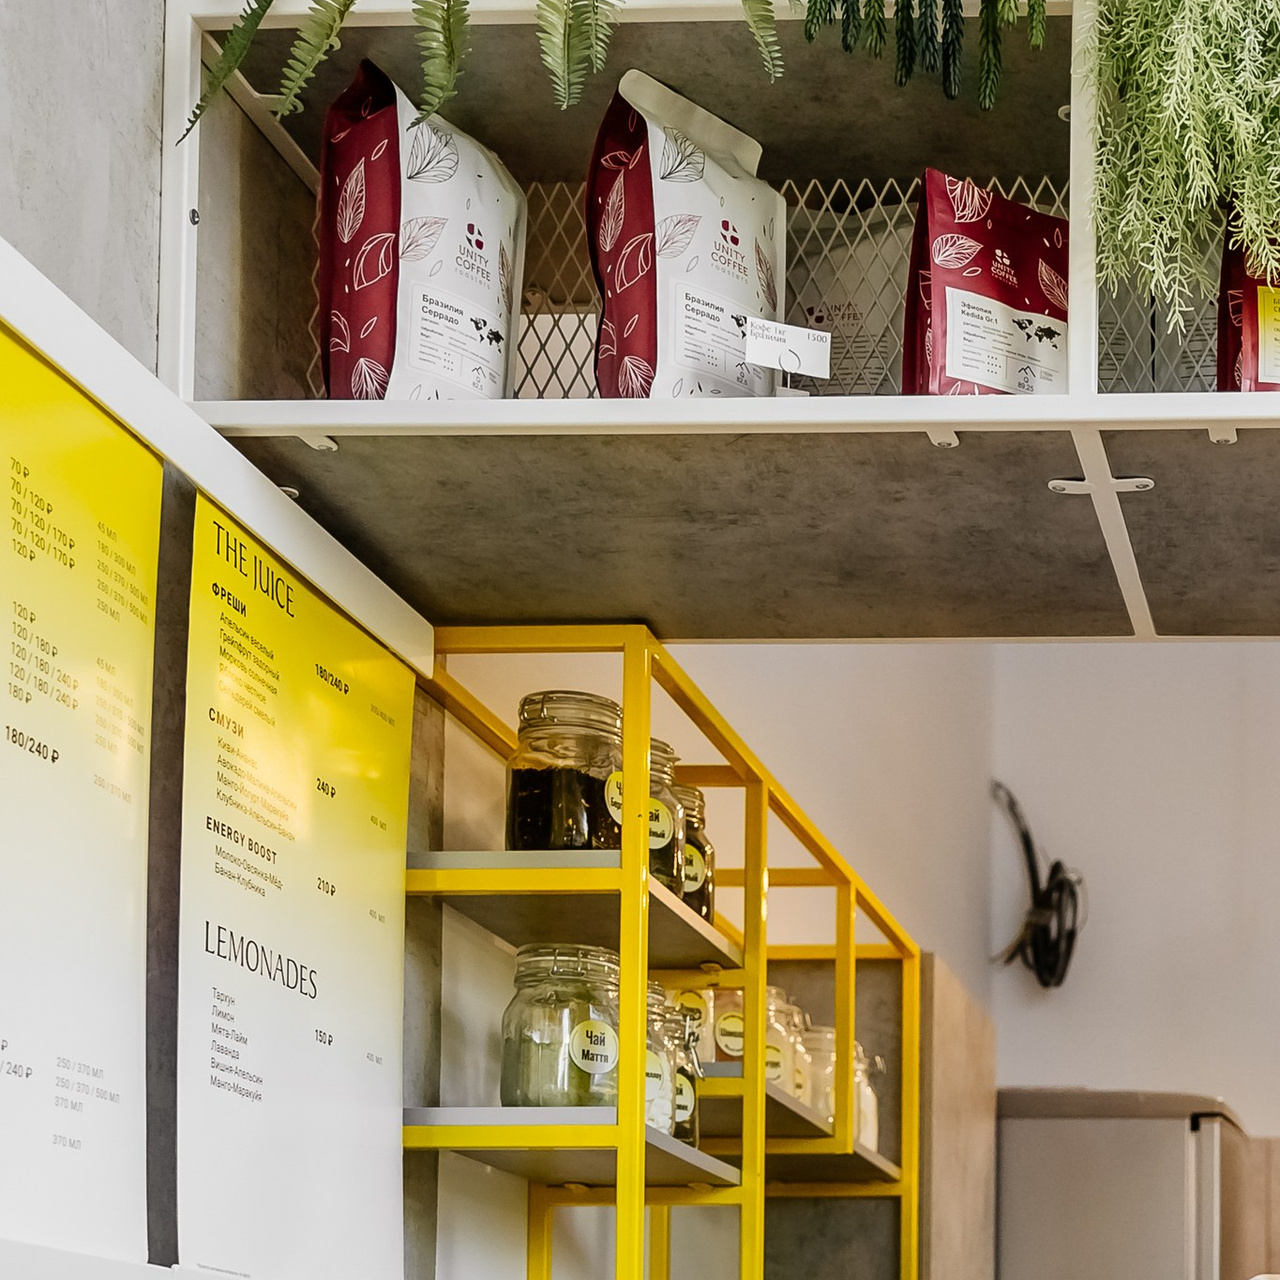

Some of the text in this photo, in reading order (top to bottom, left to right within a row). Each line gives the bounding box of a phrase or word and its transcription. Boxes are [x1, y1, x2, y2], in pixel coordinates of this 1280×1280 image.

[459, 245, 489, 268] UNITY
[714, 241, 746, 262] UNITY
[455, 256, 491, 282] COFFEE
[711, 252, 748, 277] COFFEE
[711, 263, 748, 285] roasters
[991, 267, 1017, 284] COFFEE
[992, 260, 1014, 275] UNITY
[454, 268, 491, 290] roasters
[422, 294, 464, 316] Бразилия
[684, 304, 721, 323] Серрадо
[685, 292, 725, 314] Бразилия
[961, 301, 992, 315] Эфиопия
[421, 306, 459, 326] Серрадо
[961, 309, 984, 321] Kedida
[750, 321, 772, 336] Кофе
[750, 330, 787, 344] Бразилия
[807, 332, 828, 344] 1500
[213, 520, 295, 618] THE JUICE
[211, 582, 247, 617] ФРЕШИ
[315, 663, 342, 693] 180/240
[208, 707, 244, 740] СМУЗИ
[5, 725, 48, 760] 180/240
[316, 778, 330, 796] 240
[206, 816, 277, 865] ENERGY BOOST
[317, 877, 330, 895] 210
[204, 920, 317, 999] LEMONADES
[212, 986, 235, 1008] Тархун
[211, 1005, 235, 1023] Лимон
[211, 1022, 248, 1046] Мята-Лайм
[315, 1029, 327, 1045] 150
[585, 1030, 606, 1047] Чай
[211, 1040, 240, 1060] Лаванда
[581, 1049, 609, 1064] Маття
[210, 1057, 263, 1086] Вишня-Апельсин
[210, 1074, 263, 1103] Манго-Маракуйя
